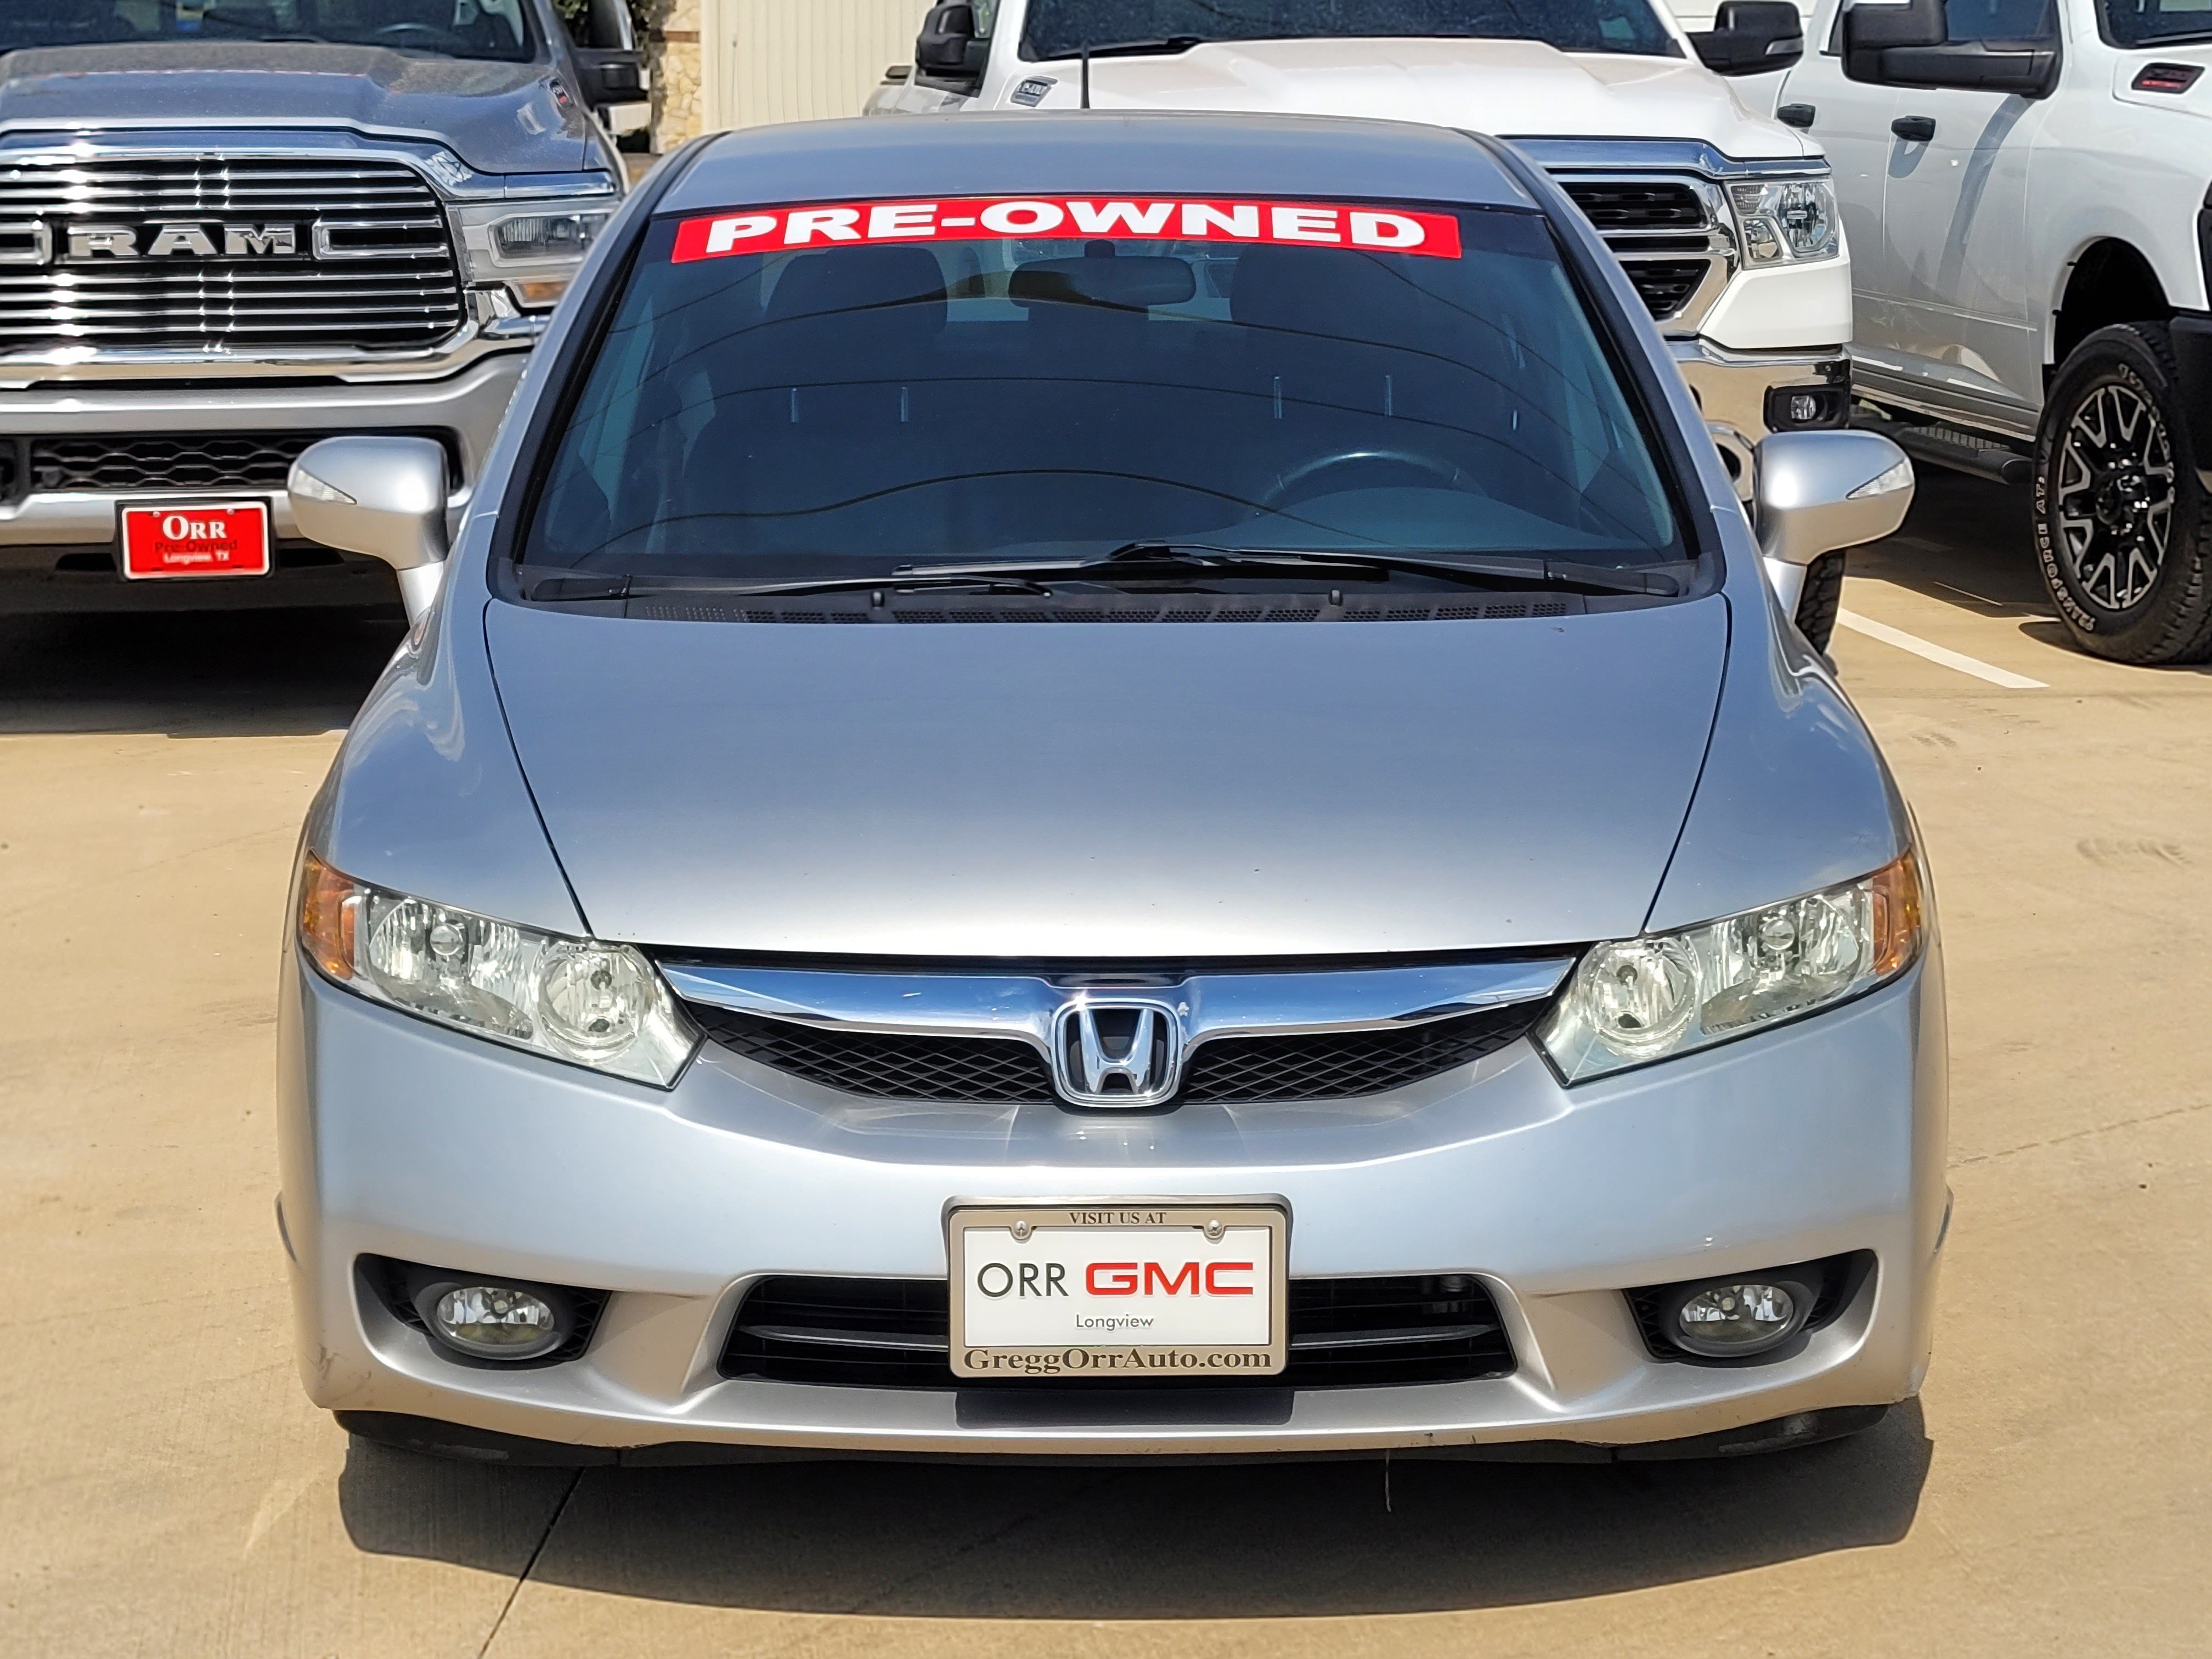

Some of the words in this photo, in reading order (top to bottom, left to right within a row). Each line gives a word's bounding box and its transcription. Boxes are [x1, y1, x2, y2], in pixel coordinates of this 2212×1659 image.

[67, 223, 296, 256] RAM
[705, 200, 1425, 253] PRE-OWNED
[216, 549, 230, 561] TX
[1069, 1212, 1113, 1224] VISIT
[1119, 1212, 1139, 1224] US
[1144, 1212, 1167, 1224] AT
[977, 1262, 1069, 1297] ORR
[1086, 1262, 1254, 1295] GMC
[1076, 1314, 1154, 1331] Longview
[964, 1348, 1271, 1374] GreggOrrAuto.com
